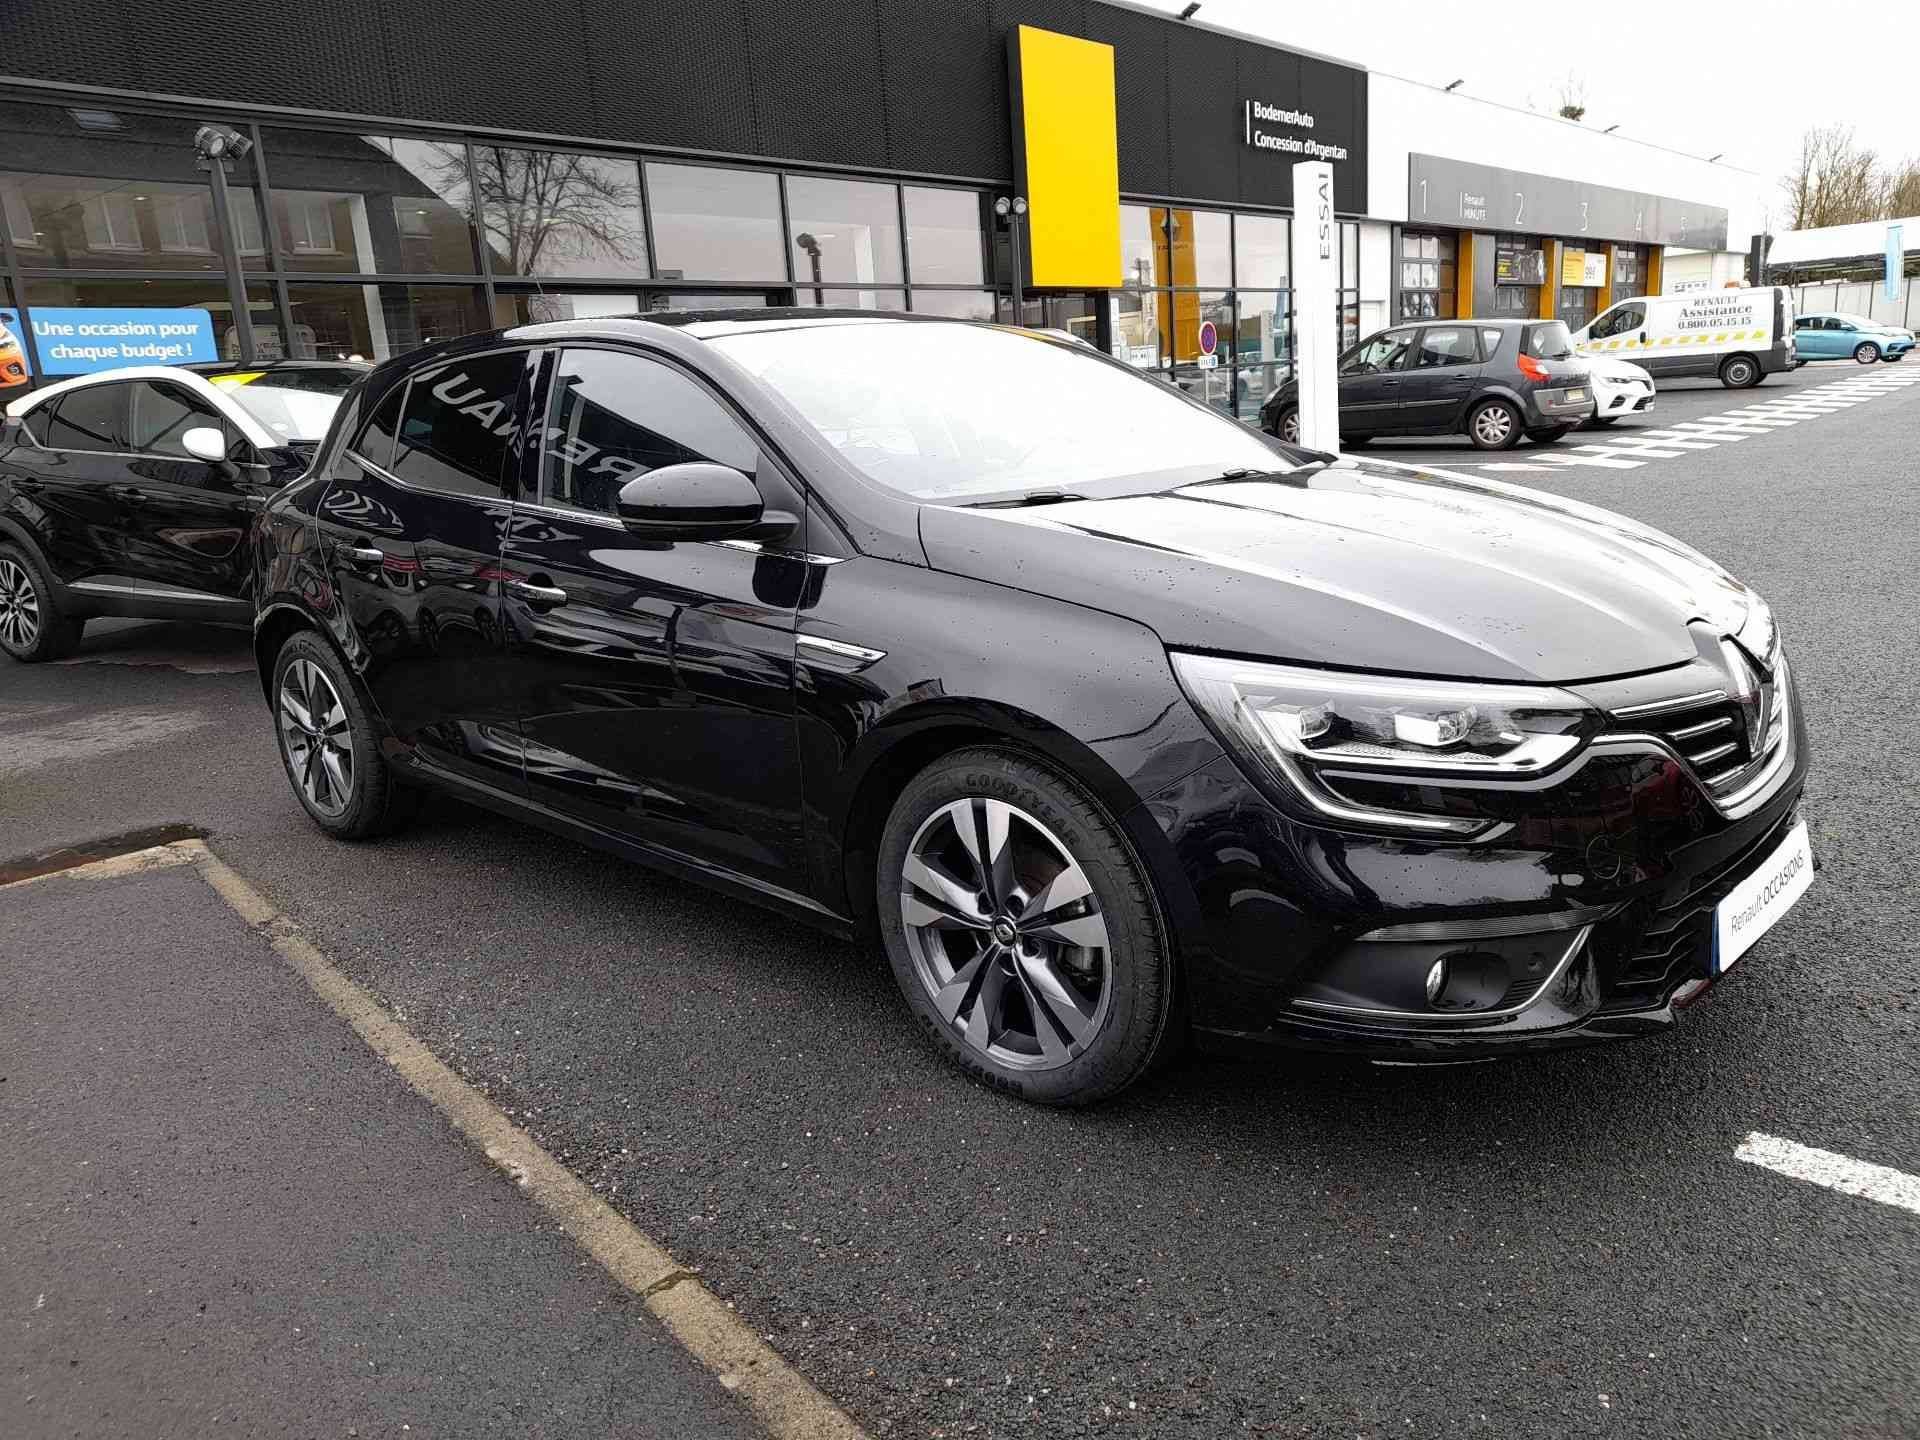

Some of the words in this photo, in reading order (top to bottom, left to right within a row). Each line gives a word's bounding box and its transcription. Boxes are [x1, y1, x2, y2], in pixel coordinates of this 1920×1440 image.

[1254, 101, 1314, 128] BodemerAuto
[1254, 130, 1303, 154] Concession
[1304, 138, 1347, 161] d'Argentan
[1419, 179, 1427, 214] 1
[1515, 192, 1524, 225] 2
[1318, 173, 1330, 260] ESSAI
[1580, 202, 1588, 231] 3
[1679, 305, 1753, 318] Assistance
[1693, 296, 1738, 307] RENAULT
[33, 321, 74, 337] Une
[79, 321, 156, 336] occasion
[160, 324, 199, 338] pour
[50, 343, 120, 361] chaque
[122, 343, 183, 360] budget
[1731, 894, 1763, 936] Renault
[1763, 849, 1804, 905] OCCASIONS
